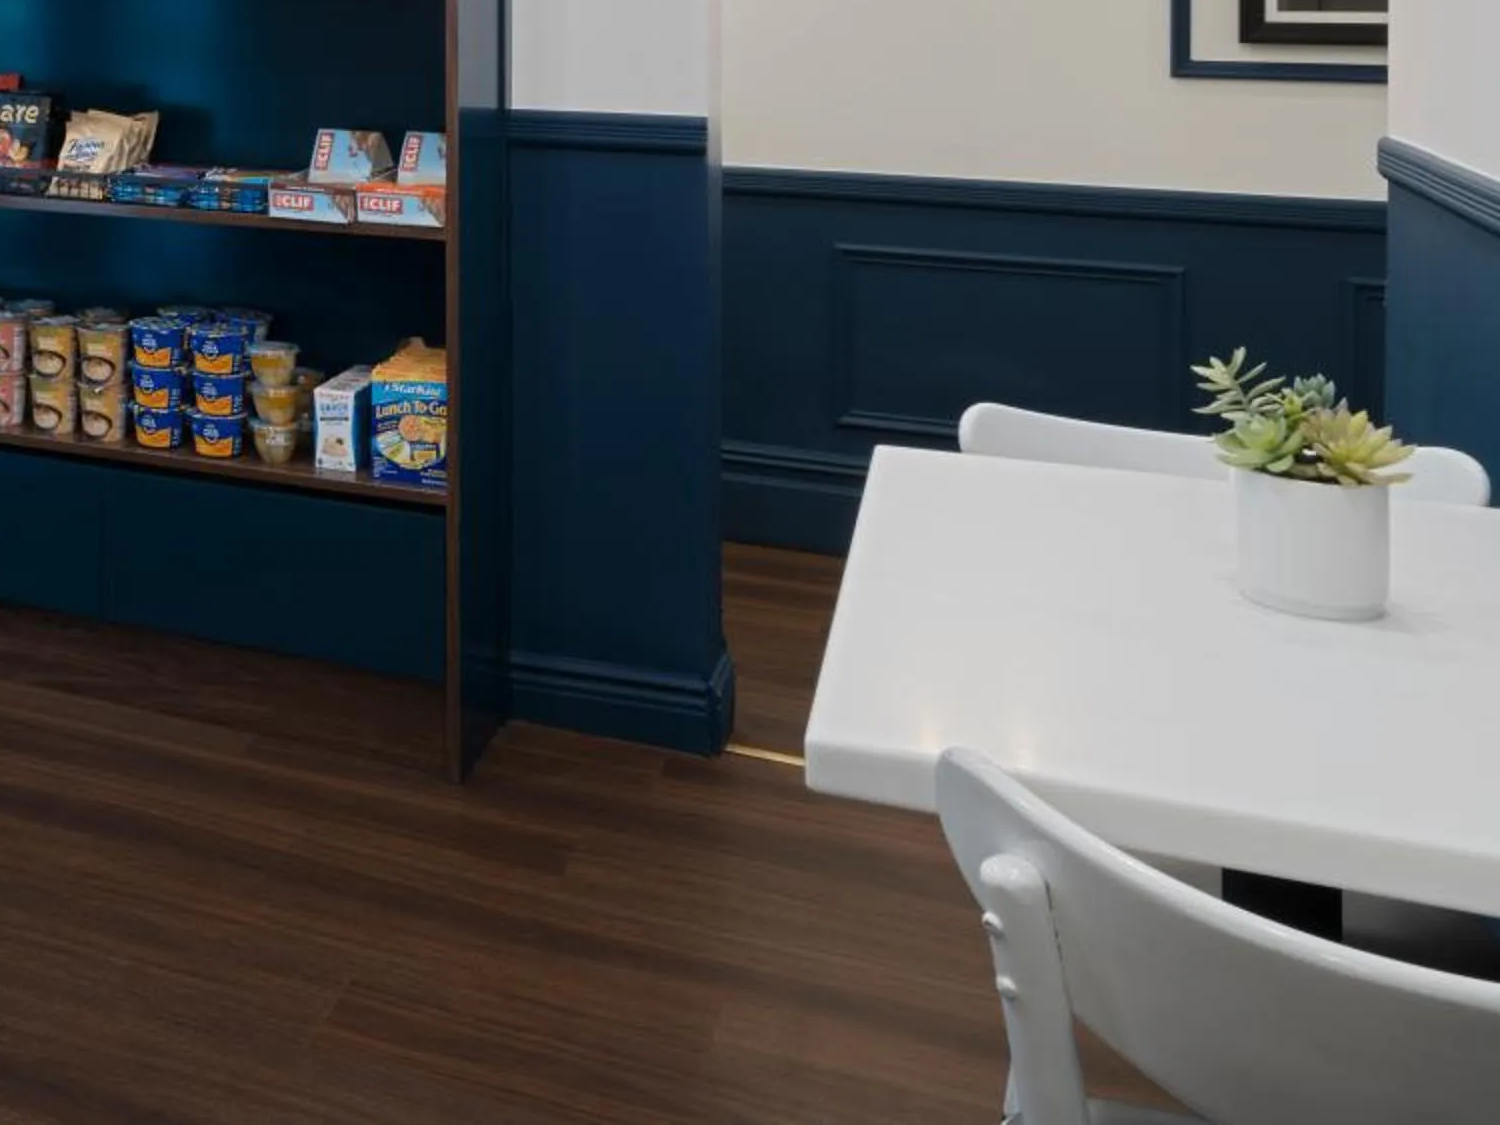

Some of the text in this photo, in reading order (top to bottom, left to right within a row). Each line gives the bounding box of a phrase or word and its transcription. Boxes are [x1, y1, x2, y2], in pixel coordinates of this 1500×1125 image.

[281, 195, 311, 209] CLIF
[369, 197, 402, 212] CLIF
[375, 402, 412, 419] Lunch
